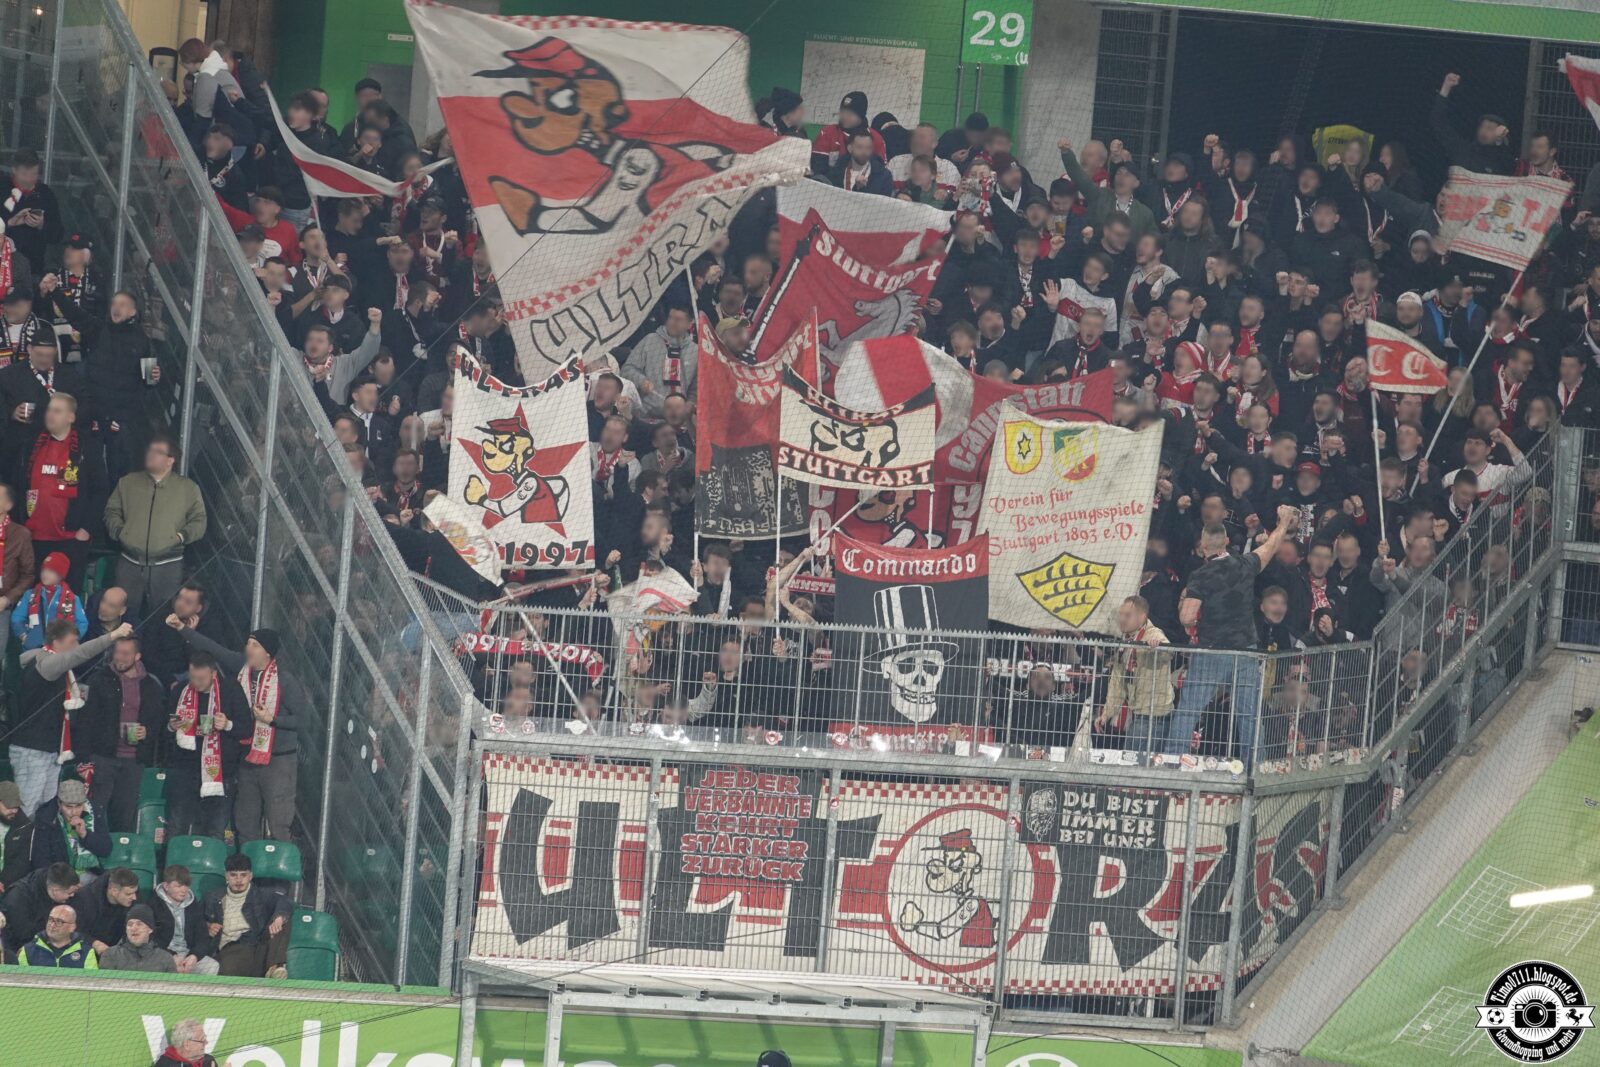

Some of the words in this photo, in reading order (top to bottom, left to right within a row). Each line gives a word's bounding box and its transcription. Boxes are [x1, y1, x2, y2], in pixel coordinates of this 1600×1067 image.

[970, 10, 1025, 48] 29
[778, 446, 932, 487] STUTTGART
[988, 491, 1045, 514] Verein
[1048, 487, 1073, 510] für
[1010, 499, 1146, 533] Bewegungsspiele
[505, 540, 589, 567] 1997
[988, 529, 1060, 557] Stuttgart
[1065, 526, 1099, 546] 1893
[842, 547, 977, 577] Commando
[701, 769, 801, 795] JEDER
[684, 786, 813, 819] VERBANNTE
[1062, 790, 1097, 809] DU
[1107, 794, 1160, 816] BIST
[694, 812, 800, 837] KEHRT
[1060, 808, 1156, 836] IMMER
[1058, 828, 1095, 845] BEI
